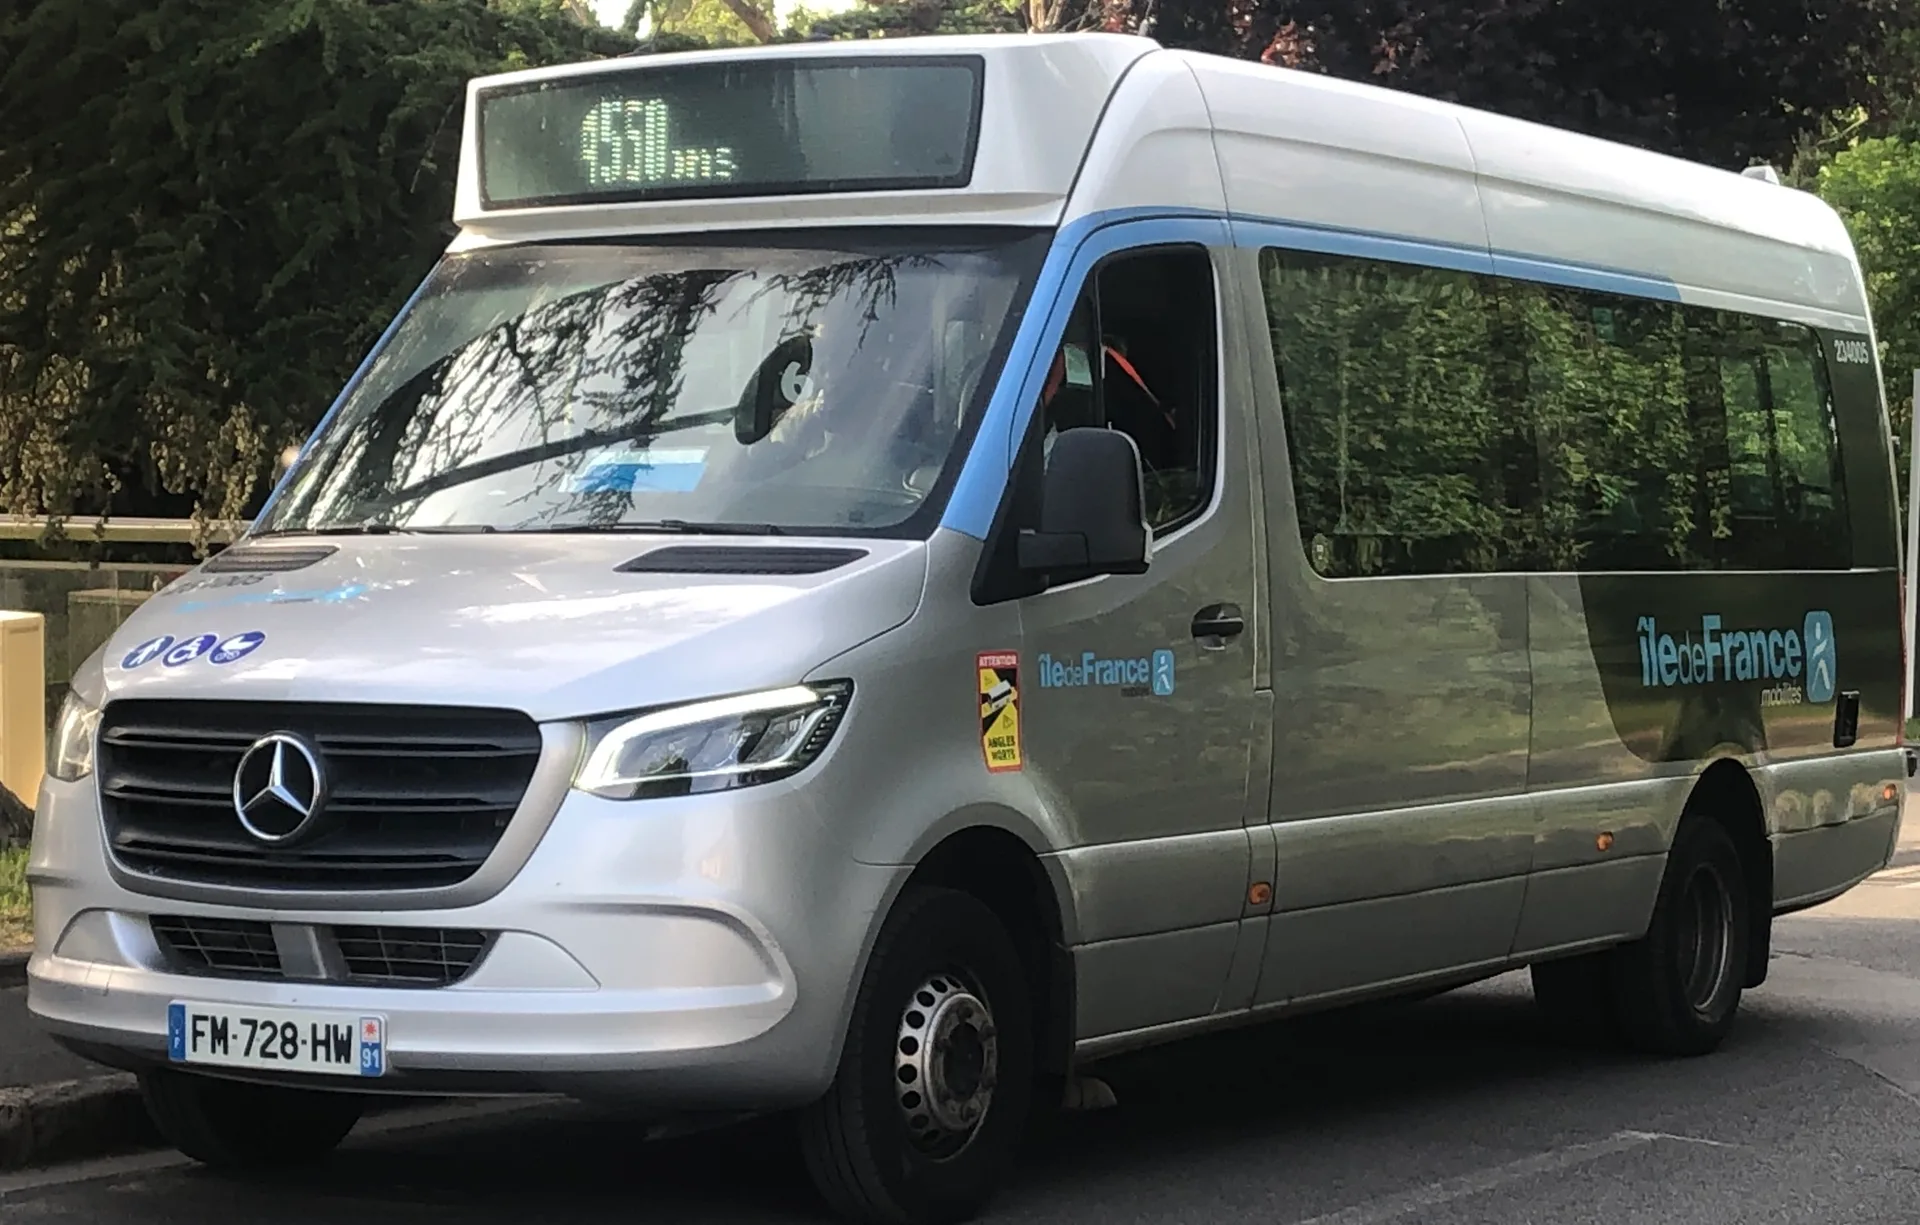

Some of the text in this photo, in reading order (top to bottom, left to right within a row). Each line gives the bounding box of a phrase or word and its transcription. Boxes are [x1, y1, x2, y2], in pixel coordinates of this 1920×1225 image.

[988, 735, 1016, 748] ANGLES
[191, 1013, 353, 1064] FM-728-HW
[361, 1047, 380, 1068] 91
